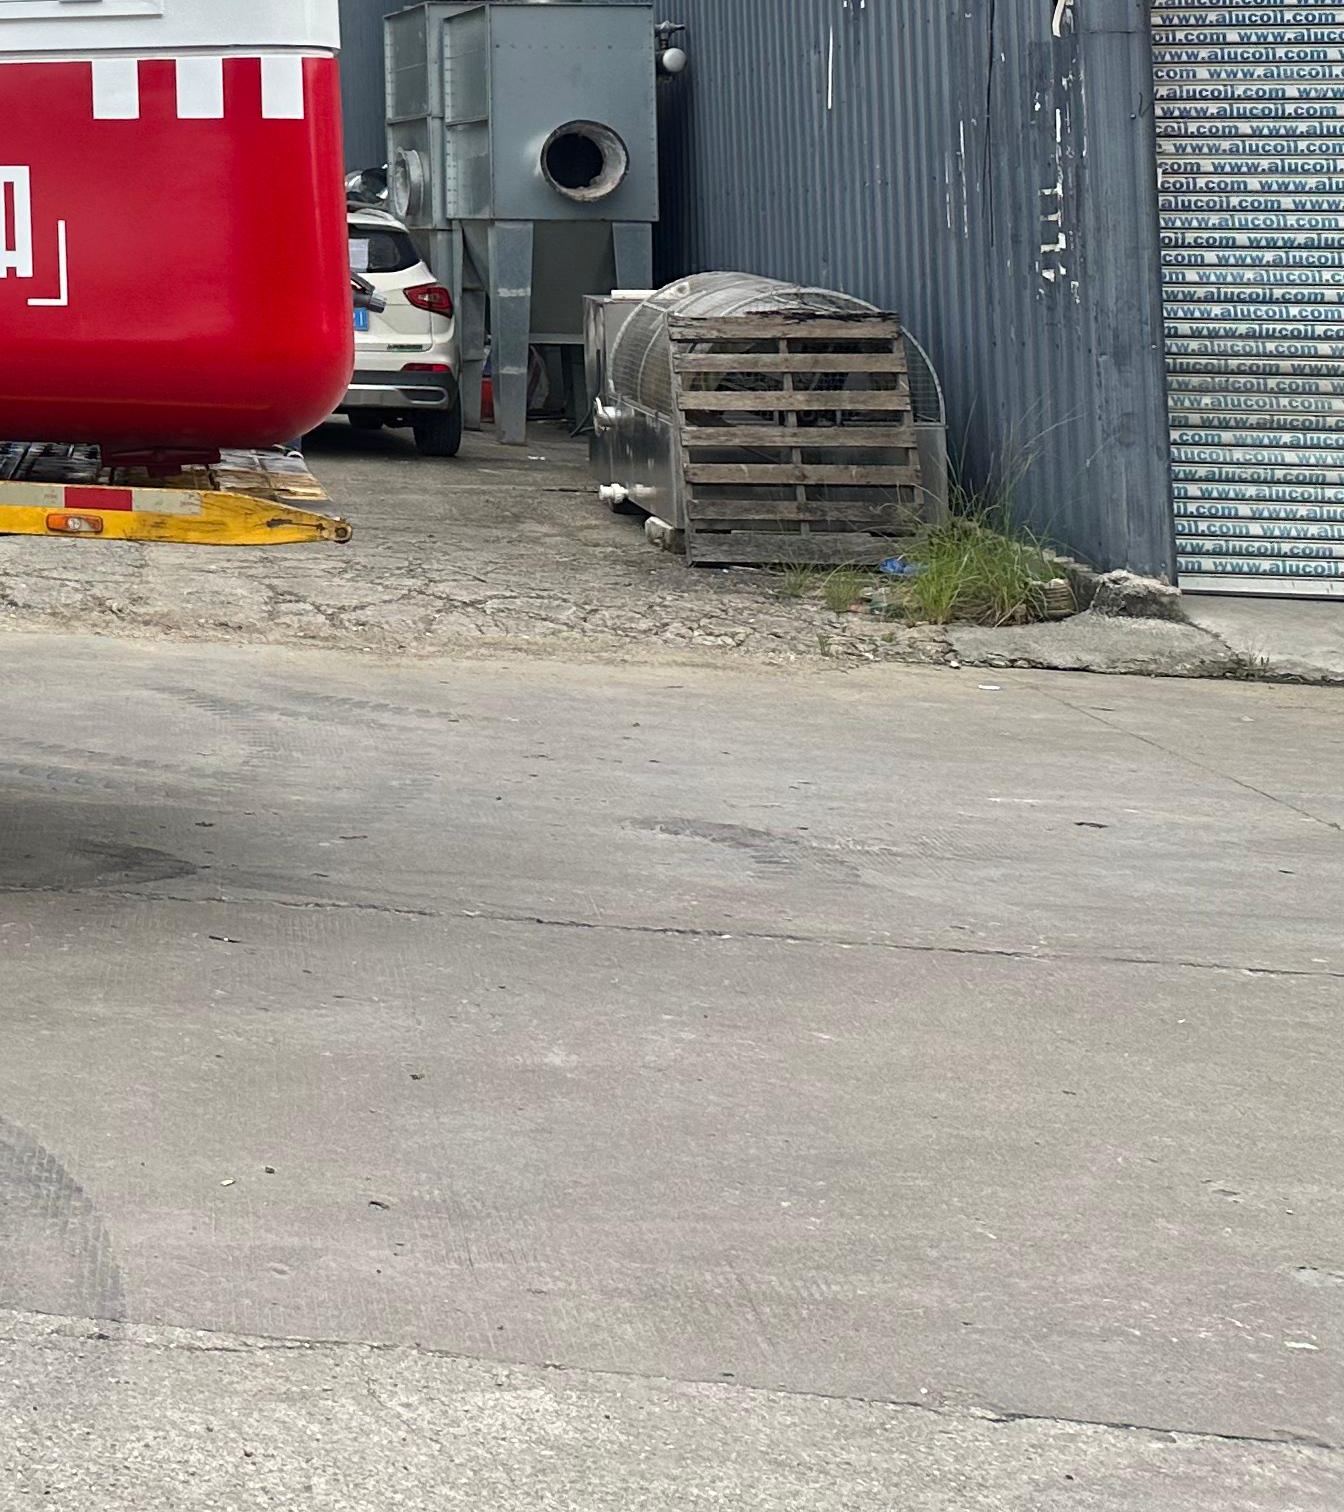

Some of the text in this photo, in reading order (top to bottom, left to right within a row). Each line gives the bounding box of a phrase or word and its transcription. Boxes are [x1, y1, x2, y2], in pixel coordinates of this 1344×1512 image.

[1160, 10, 1336, 24] www.alucoil.com
[1152, 31, 1226, 43] oil.com
[1153, 46, 1327, 61] www.alucoil.com
[1207, 64, 1344, 79] www.alucoil.
[1161, 103, 1337, 117] www.alucoil.com
[1160, 177, 1248, 191] coil.com
[1161, 195, 1280, 209] alucoil.com
[1161, 214, 1339, 228] www.alucoil.com
[1162, 233, 1236, 247] oil.com
[1197, 270, 1344, 283] www.alucoil.c
[1164, 304, 1341, 319] www.alucoil.com
[1170, 395, 1332, 410] ww.alucoil.com
